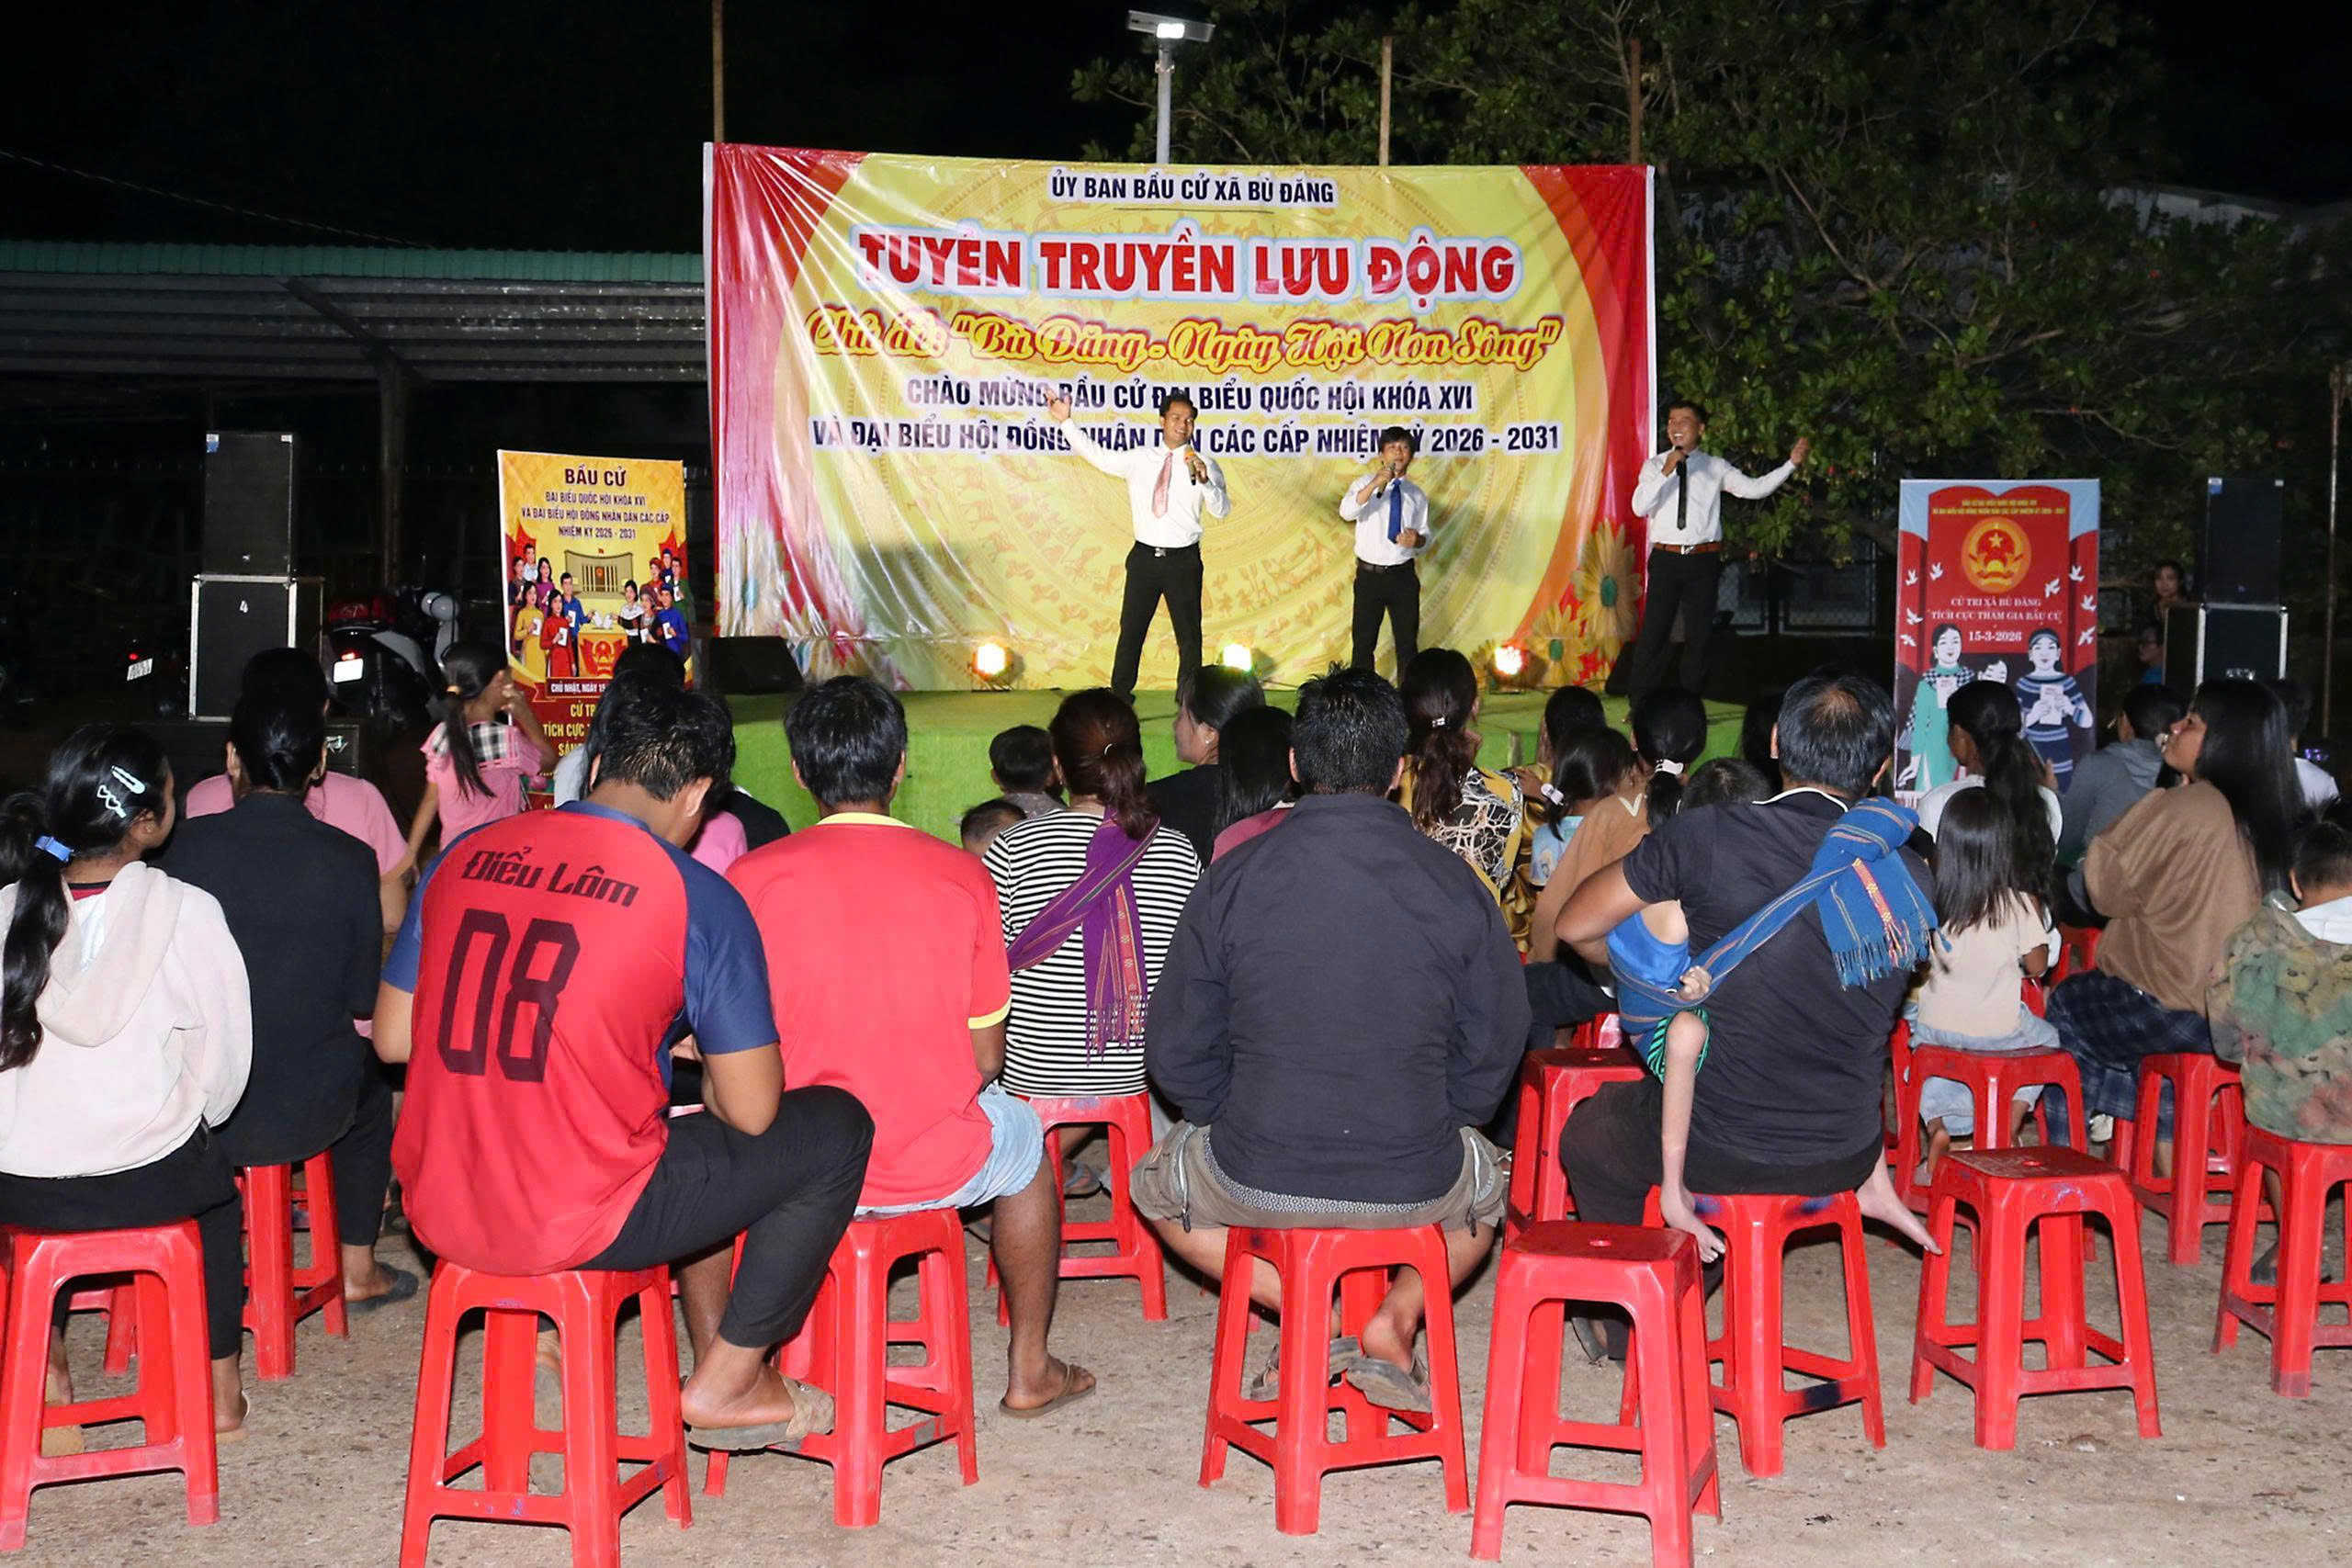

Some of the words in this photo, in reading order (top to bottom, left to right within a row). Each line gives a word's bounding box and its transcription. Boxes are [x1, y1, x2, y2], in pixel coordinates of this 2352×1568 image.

[1051, 169, 1078, 197] ỦY
[1084, 177, 1126, 198] BAN
[1133, 171, 1174, 199] BẦU
[1182, 172, 1210, 200] CỬ
[1215, 176, 1241, 201] XÃ
[1248, 176, 1273, 202] BÙ
[1279, 175, 1333, 203] ĐĂNG
[859, 228, 1021, 288] TUYÊN
[1040, 228, 1234, 292] TRUYỀN
[1255, 245, 1350, 296] LƯU
[1367, 235, 1515, 308] ĐỘNG
[956, 319, 1028, 356] "Bù
[1040, 321, 1146, 367] Đăng
[1173, 323, 1275, 368] Ngày
[1287, 325, 1359, 367] Hội
[1372, 326, 1447, 360] Non
[907, 375, 971, 406] CHÀO
[978, 376, 1049, 407] MỪNG
[1058, 376, 1106, 408] BẦU
[1114, 378, 1148, 409] CỬ
[1199, 378, 1251, 411] BIỂU
[1260, 377, 1319, 412] QUỐC
[1328, 381, 1365, 415] HỘI
[1373, 381, 1432, 411] KHÓA
[1439, 386, 1473, 411] XVI
[813, 415, 843, 446] VÀ
[851, 421, 890, 452] ĐẠI
[898, 413, 952, 448] BIỂU
[959, 419, 999, 454] HỘI
[1006, 418, 1071, 451] ĐỒNG
[1154, 428, 1202, 453] DN
[1210, 423, 1255, 453] CÁC
[1263, 421, 1309, 453] CẤP
[1431, 428, 1485, 452] 2026
[1507, 425, 1558, 450] 2031
[564, 464, 598, 485] BẦU
[604, 466, 627, 487] CỬ
[1968, 630, 2022, 642] 15-3-2026
[543, 721, 564, 738] TÍCH
[566, 722, 585, 740] CỰC
[436, 908, 581, 1083] 08
